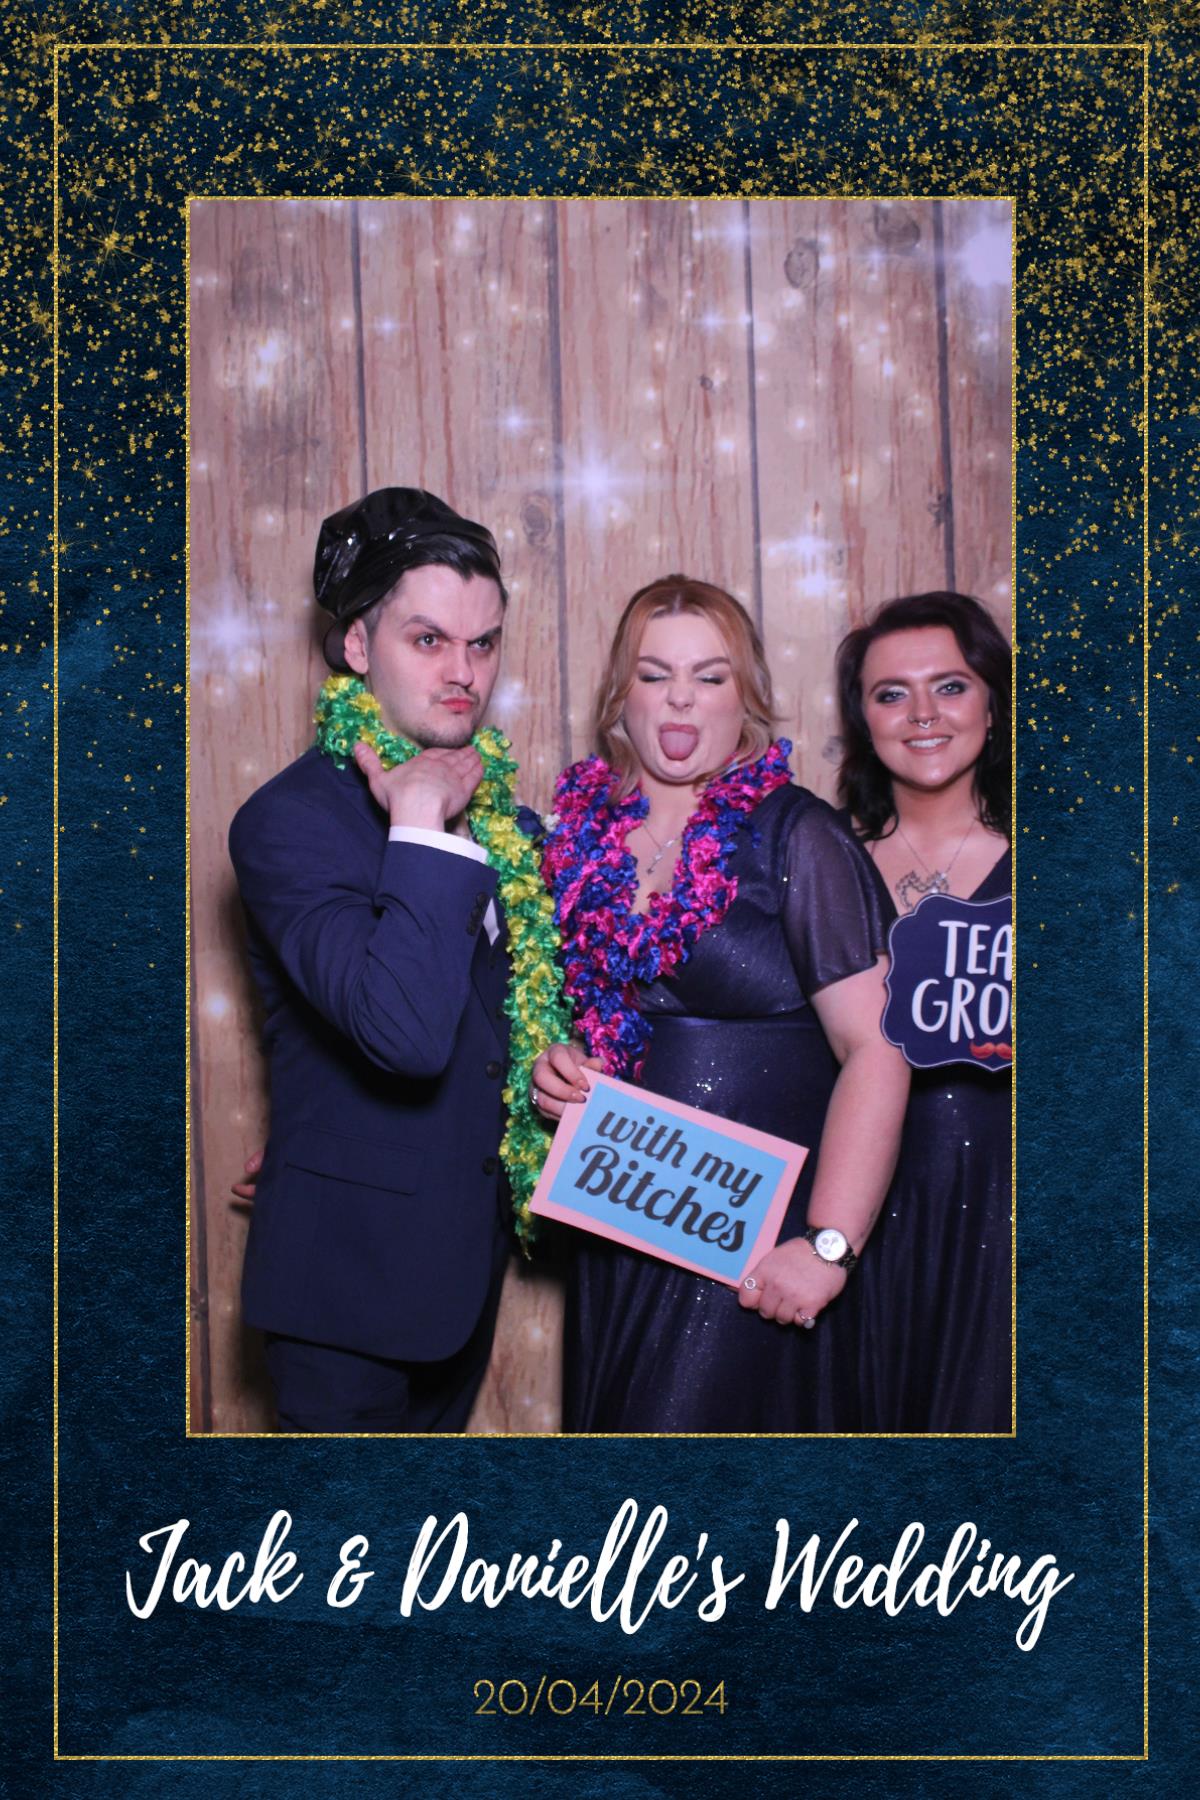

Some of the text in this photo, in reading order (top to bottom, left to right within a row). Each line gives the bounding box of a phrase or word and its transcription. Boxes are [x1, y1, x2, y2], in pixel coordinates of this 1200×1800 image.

[911, 977, 1013, 1043] GRO
[573, 1144, 747, 1253] Bitches
[595, 1110, 764, 1209] with my
